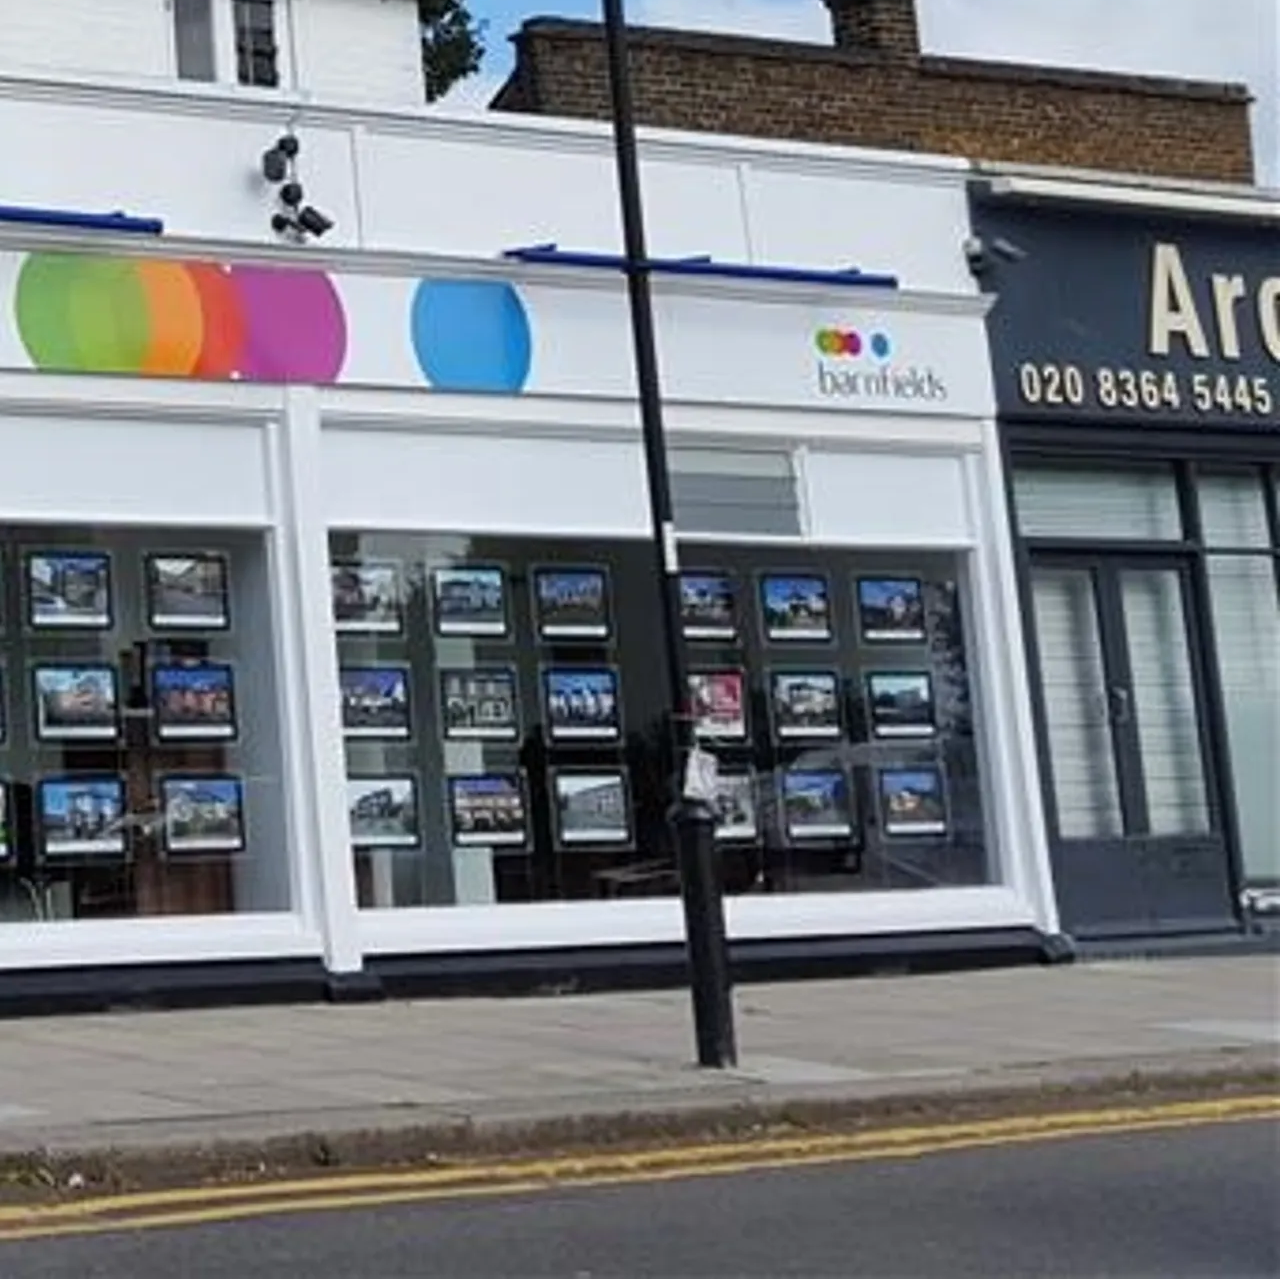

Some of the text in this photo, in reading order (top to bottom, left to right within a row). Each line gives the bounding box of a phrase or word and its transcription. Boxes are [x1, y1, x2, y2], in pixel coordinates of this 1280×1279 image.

[1020, 362, 1273, 414] 020 8364 5445
